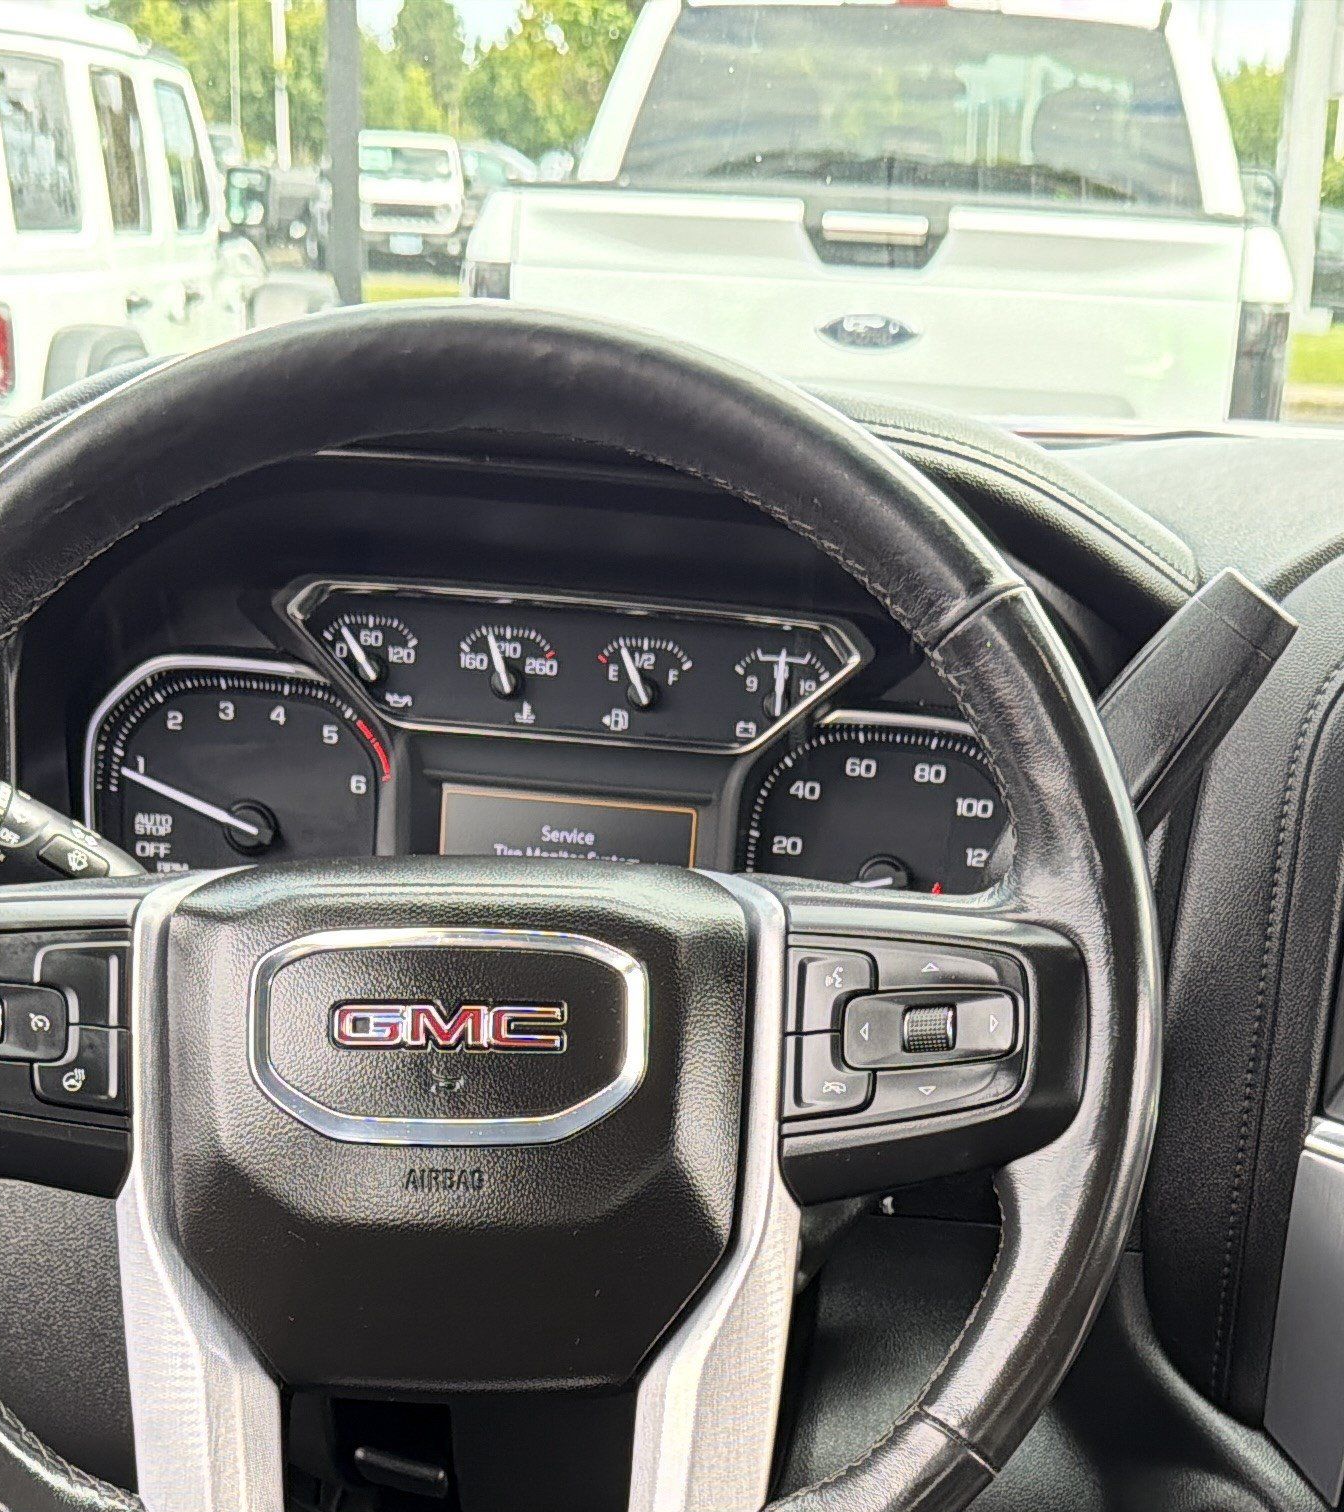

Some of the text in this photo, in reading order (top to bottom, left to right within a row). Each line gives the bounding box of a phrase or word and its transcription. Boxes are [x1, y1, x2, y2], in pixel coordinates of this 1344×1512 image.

[360, 630, 383, 647] 60
[335, 643, 348, 658] 0
[388, 646, 415, 664] 120
[460, 653, 488, 670] 160
[525, 657, 557, 676] 260
[634, 652, 655, 669] 1/2
[608, 664, 619, 682] E
[667, 668, 679, 686] F
[745, 675, 758, 692] 9
[218, 701, 235, 720] 3
[270, 706, 286, 725] 4
[166, 711, 183, 731] 2
[322, 725, 338, 744] 5
[135, 755, 145, 774] 1
[845, 757, 877, 778] 60
[913, 762, 947, 784] 80
[350, 774, 366, 795] 6
[789, 780, 821, 801] 40
[955, 797, 994, 819] 100
[134, 812, 172, 826] AUTO
[134, 824, 171, 837] STOP
[541, 824, 595, 846] Service
[135, 842, 171, 857] OFF
[771, 835, 803, 856] 20
[965, 847, 989, 868] 12
[333, 1002, 563, 1050] GMC
[404, 1168, 485, 1191] AIRBAG
